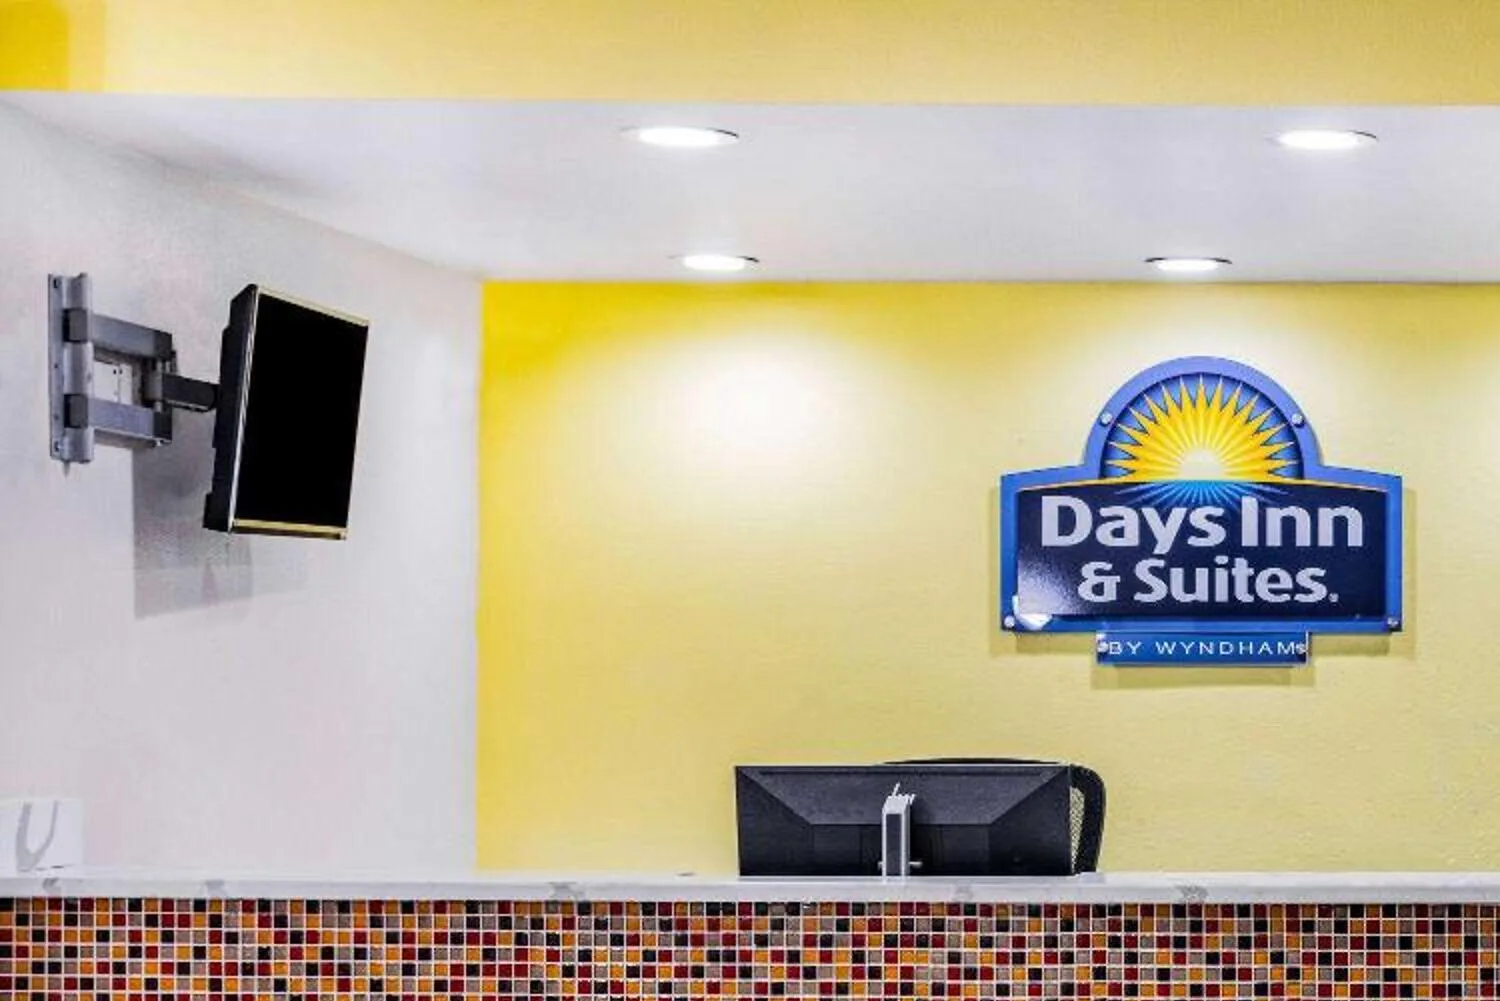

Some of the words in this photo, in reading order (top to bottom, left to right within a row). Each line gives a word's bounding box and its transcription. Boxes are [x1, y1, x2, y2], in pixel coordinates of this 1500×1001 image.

[1041, 495, 1227, 554] Days
[1241, 496, 1363, 547] Inn
[1077, 561, 1121, 602] &
[1109, 640, 1142, 655] BY
[1156, 640, 1296, 655] WYNDHAM
